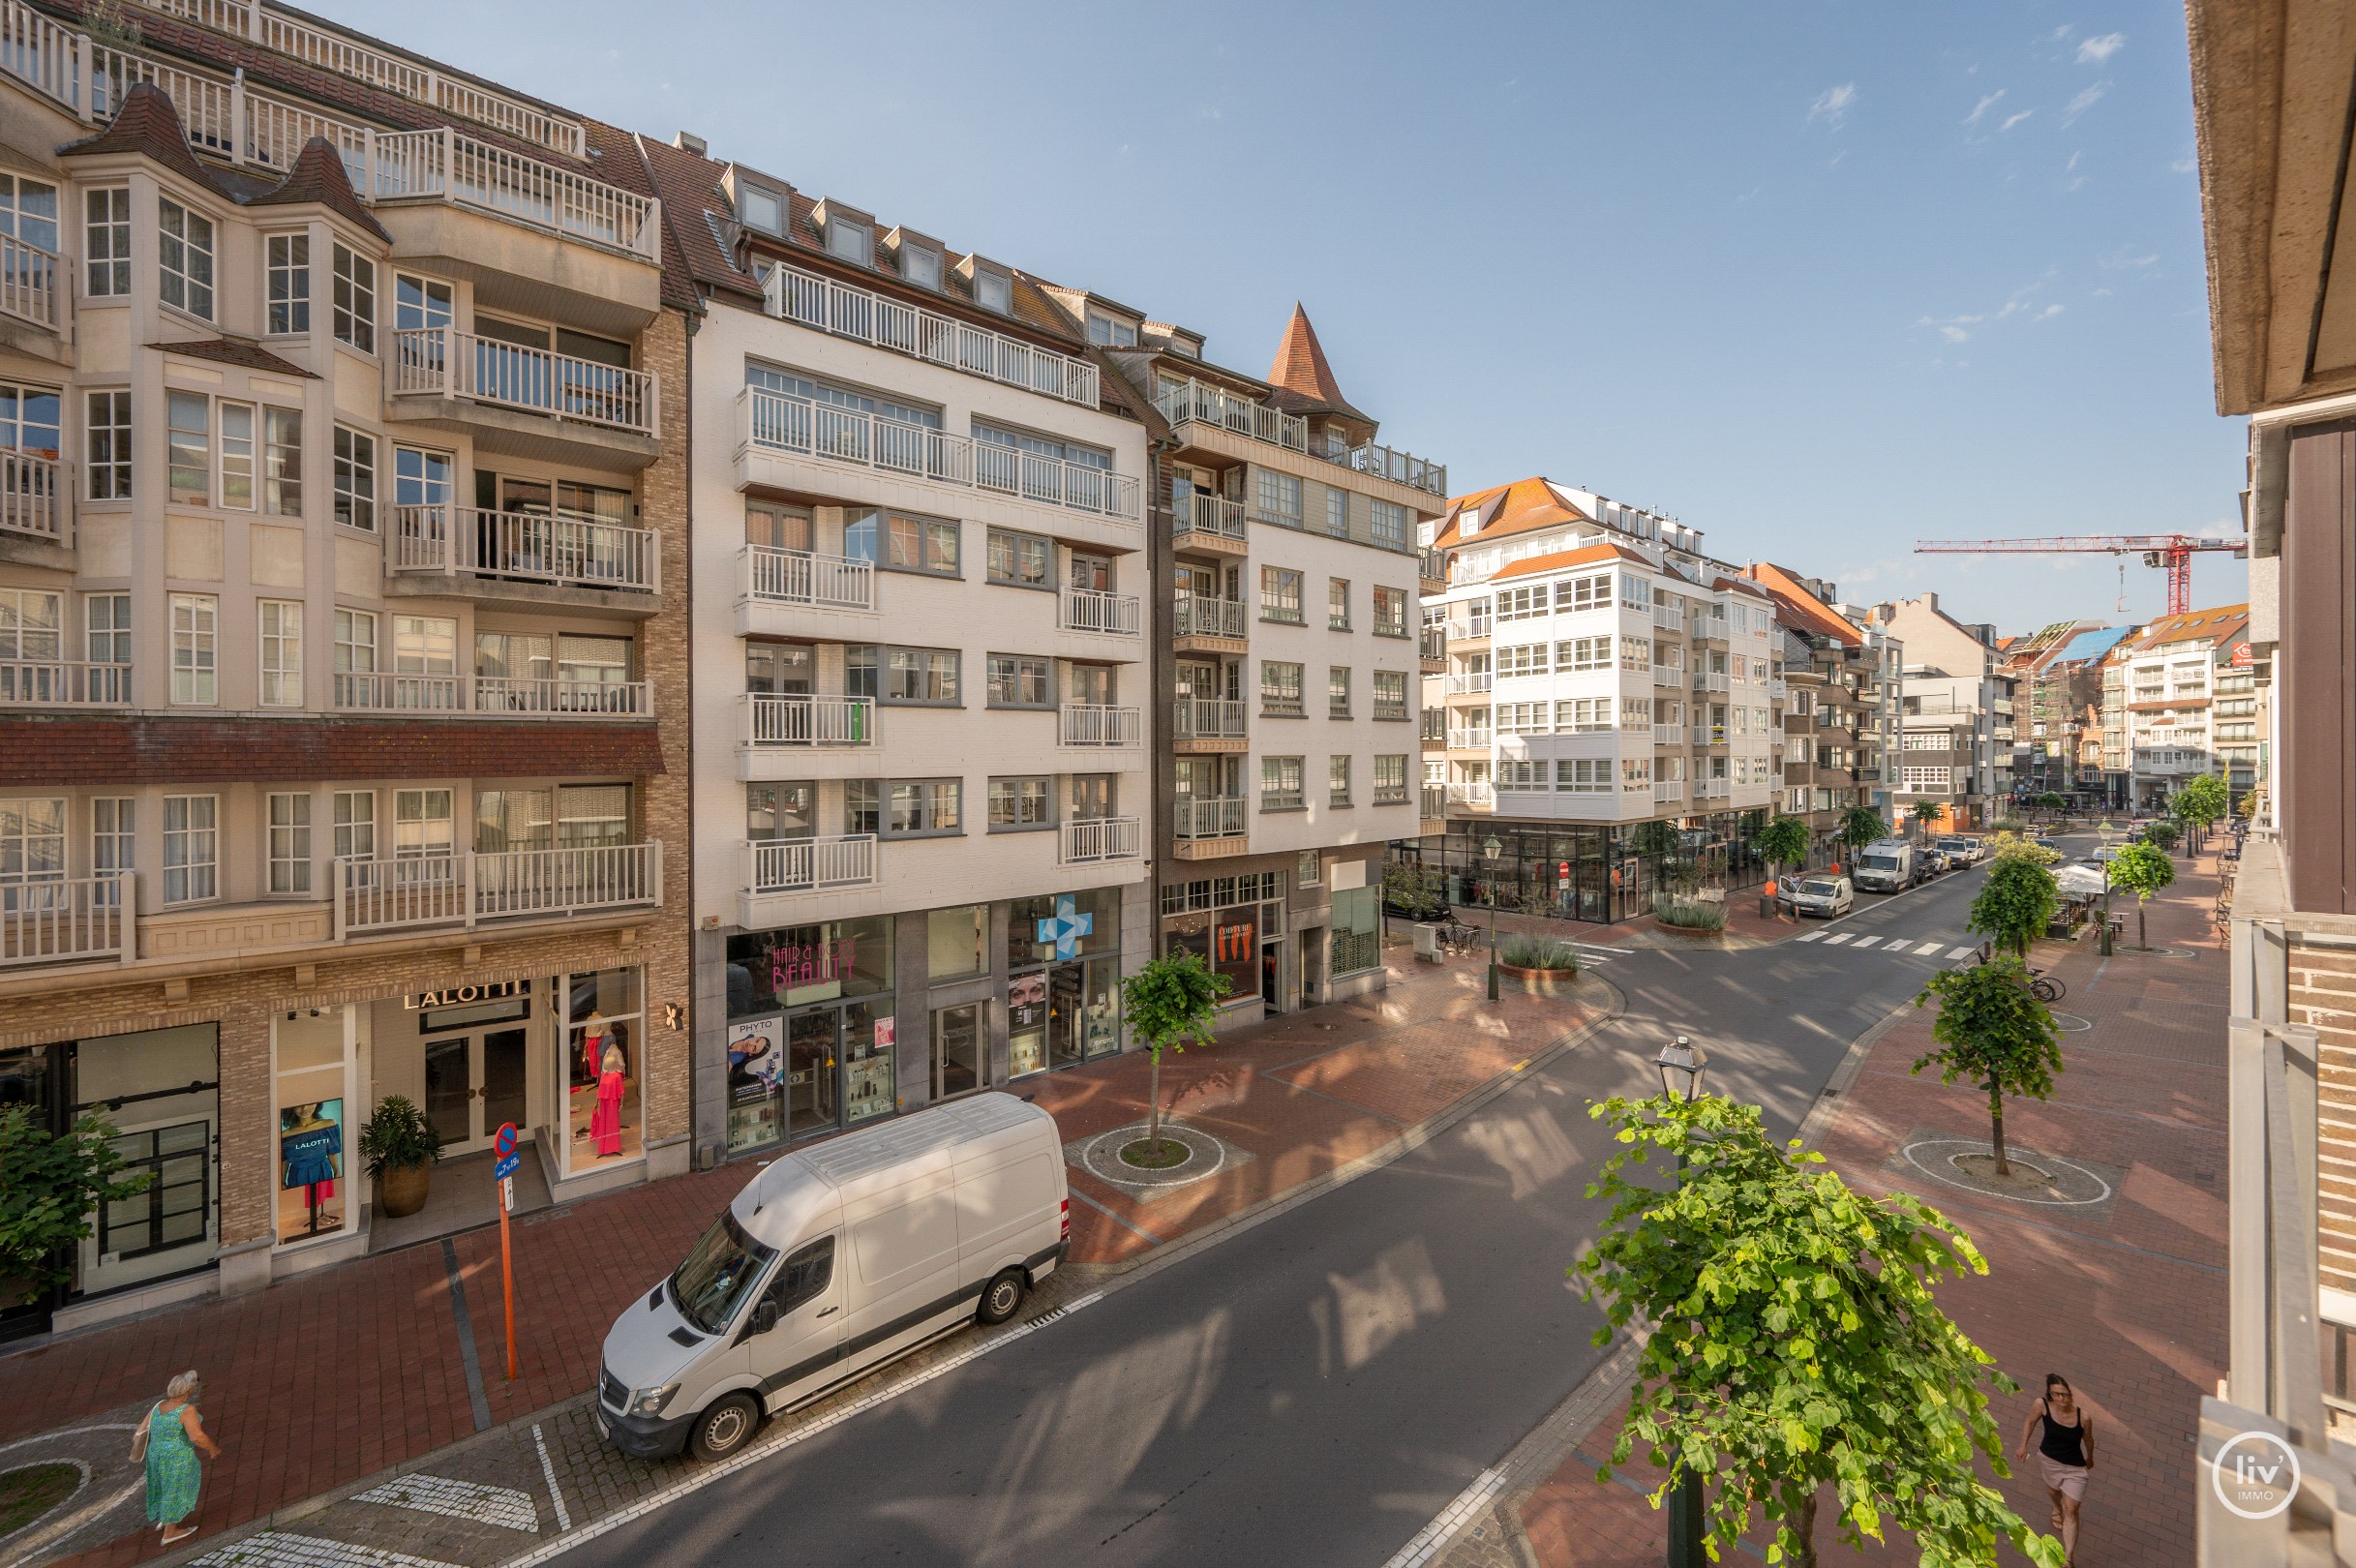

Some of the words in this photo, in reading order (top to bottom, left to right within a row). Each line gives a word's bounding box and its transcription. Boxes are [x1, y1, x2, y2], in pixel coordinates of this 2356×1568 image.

[773, 947, 800, 964] HAIR
[802, 945, 812, 960] &
[817, 939, 856, 959] BODY
[773, 957, 856, 992] BEAUTY
[740, 1020, 772, 1033] PHYTO
[295, 1137, 330, 1150] LALOTTI
